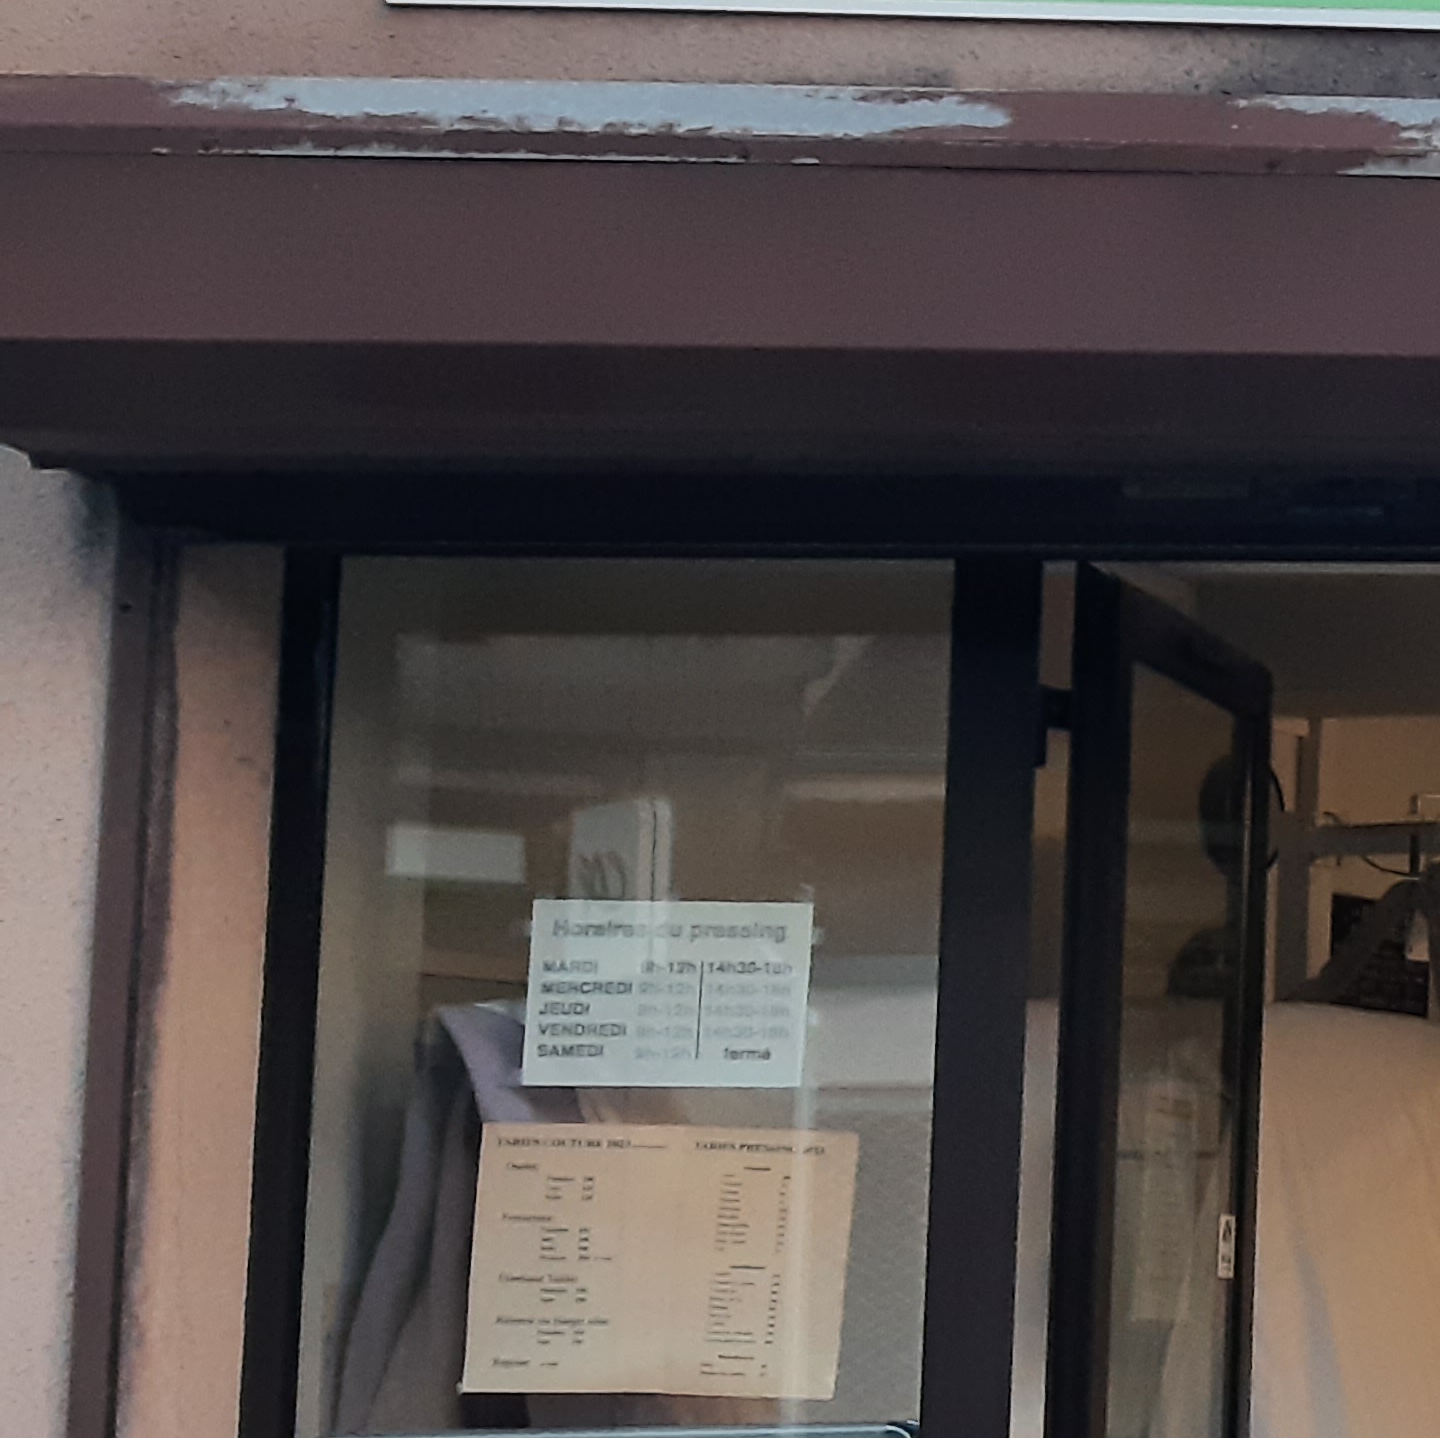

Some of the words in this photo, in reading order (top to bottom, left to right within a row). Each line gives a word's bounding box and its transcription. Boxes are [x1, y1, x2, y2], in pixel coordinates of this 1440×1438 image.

[690, 921, 788, 943] pressing
[542, 961, 598, 973] MARDI
[540, 981, 633, 995] MERCREDI
[538, 1002, 591, 1015] JEUDI
[537, 1023, 628, 1037] VENDREDI
[537, 1044, 604, 1057] SAMEDI
